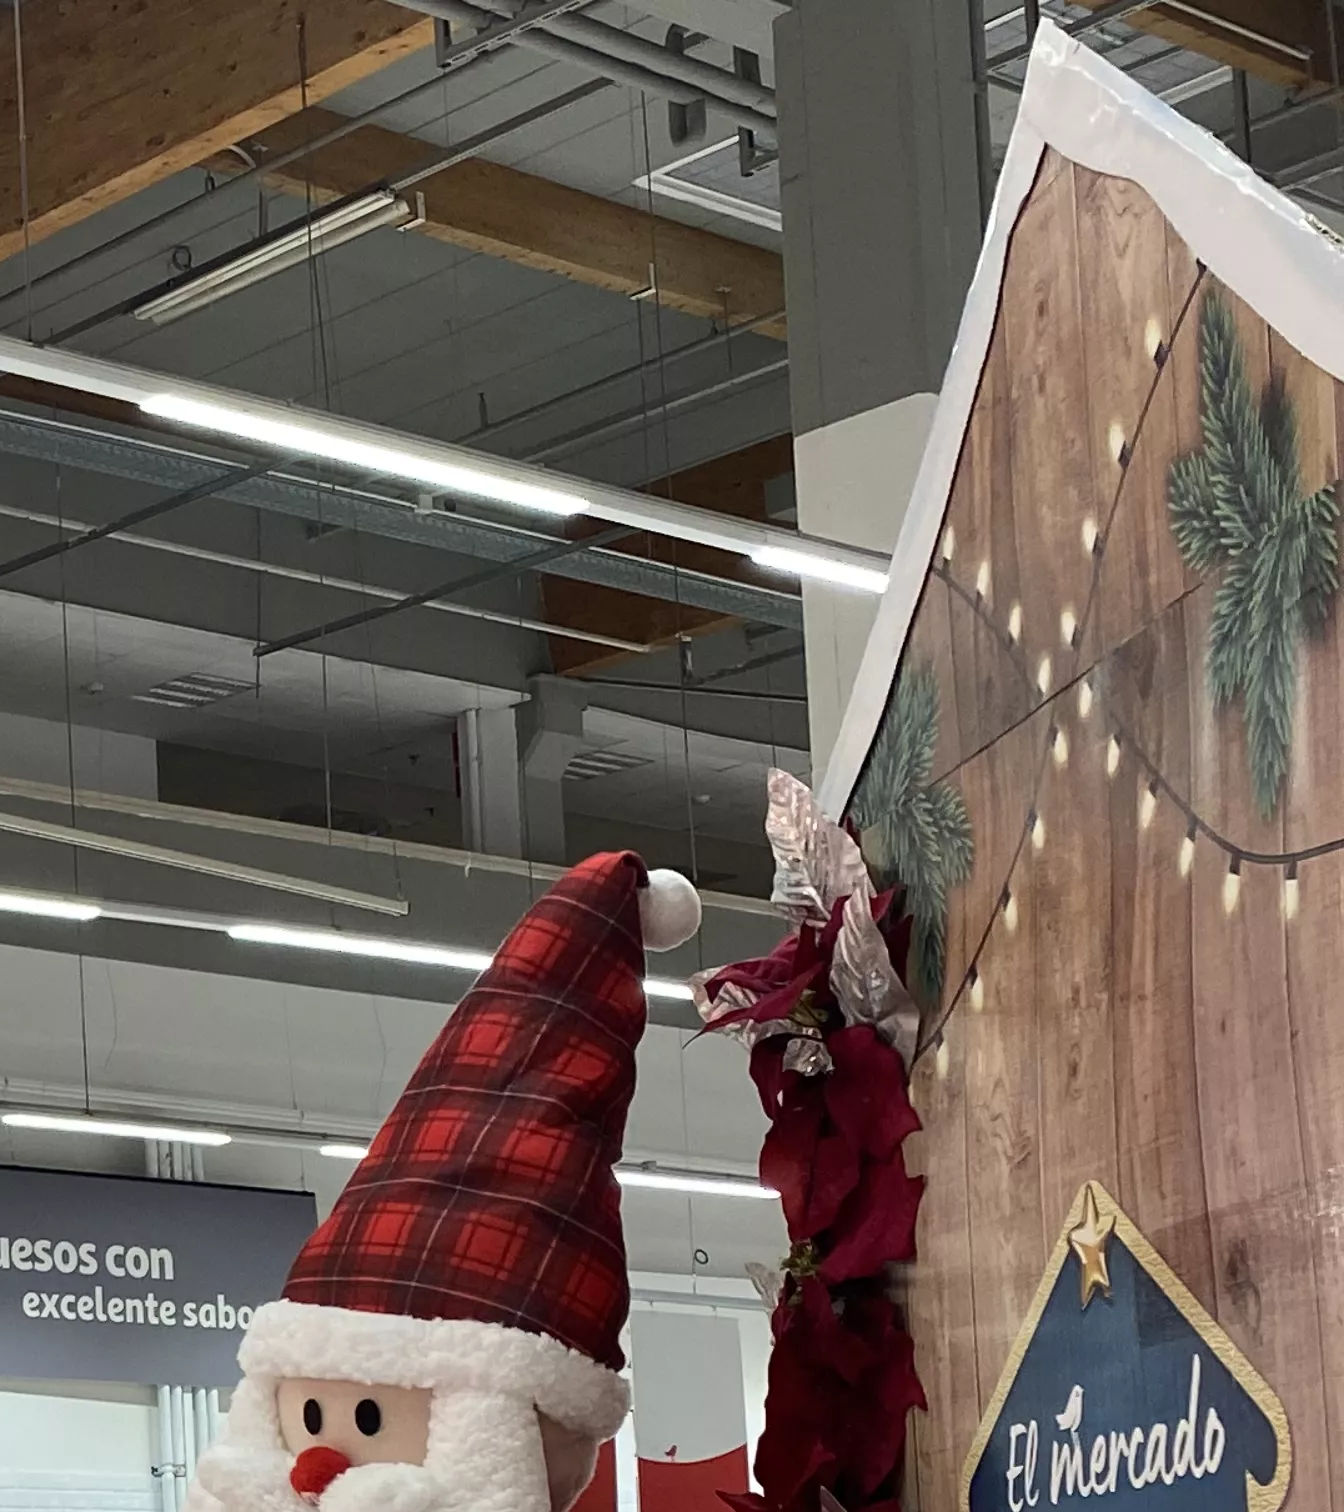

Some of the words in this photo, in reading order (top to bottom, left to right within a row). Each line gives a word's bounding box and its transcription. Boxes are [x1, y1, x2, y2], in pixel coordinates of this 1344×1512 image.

[105, 1245, 175, 1280] con
[22, 1285, 177, 1326] excelente
[182, 1294, 255, 1331] sabo
[1050, 1354, 1226, 1505] mercado
